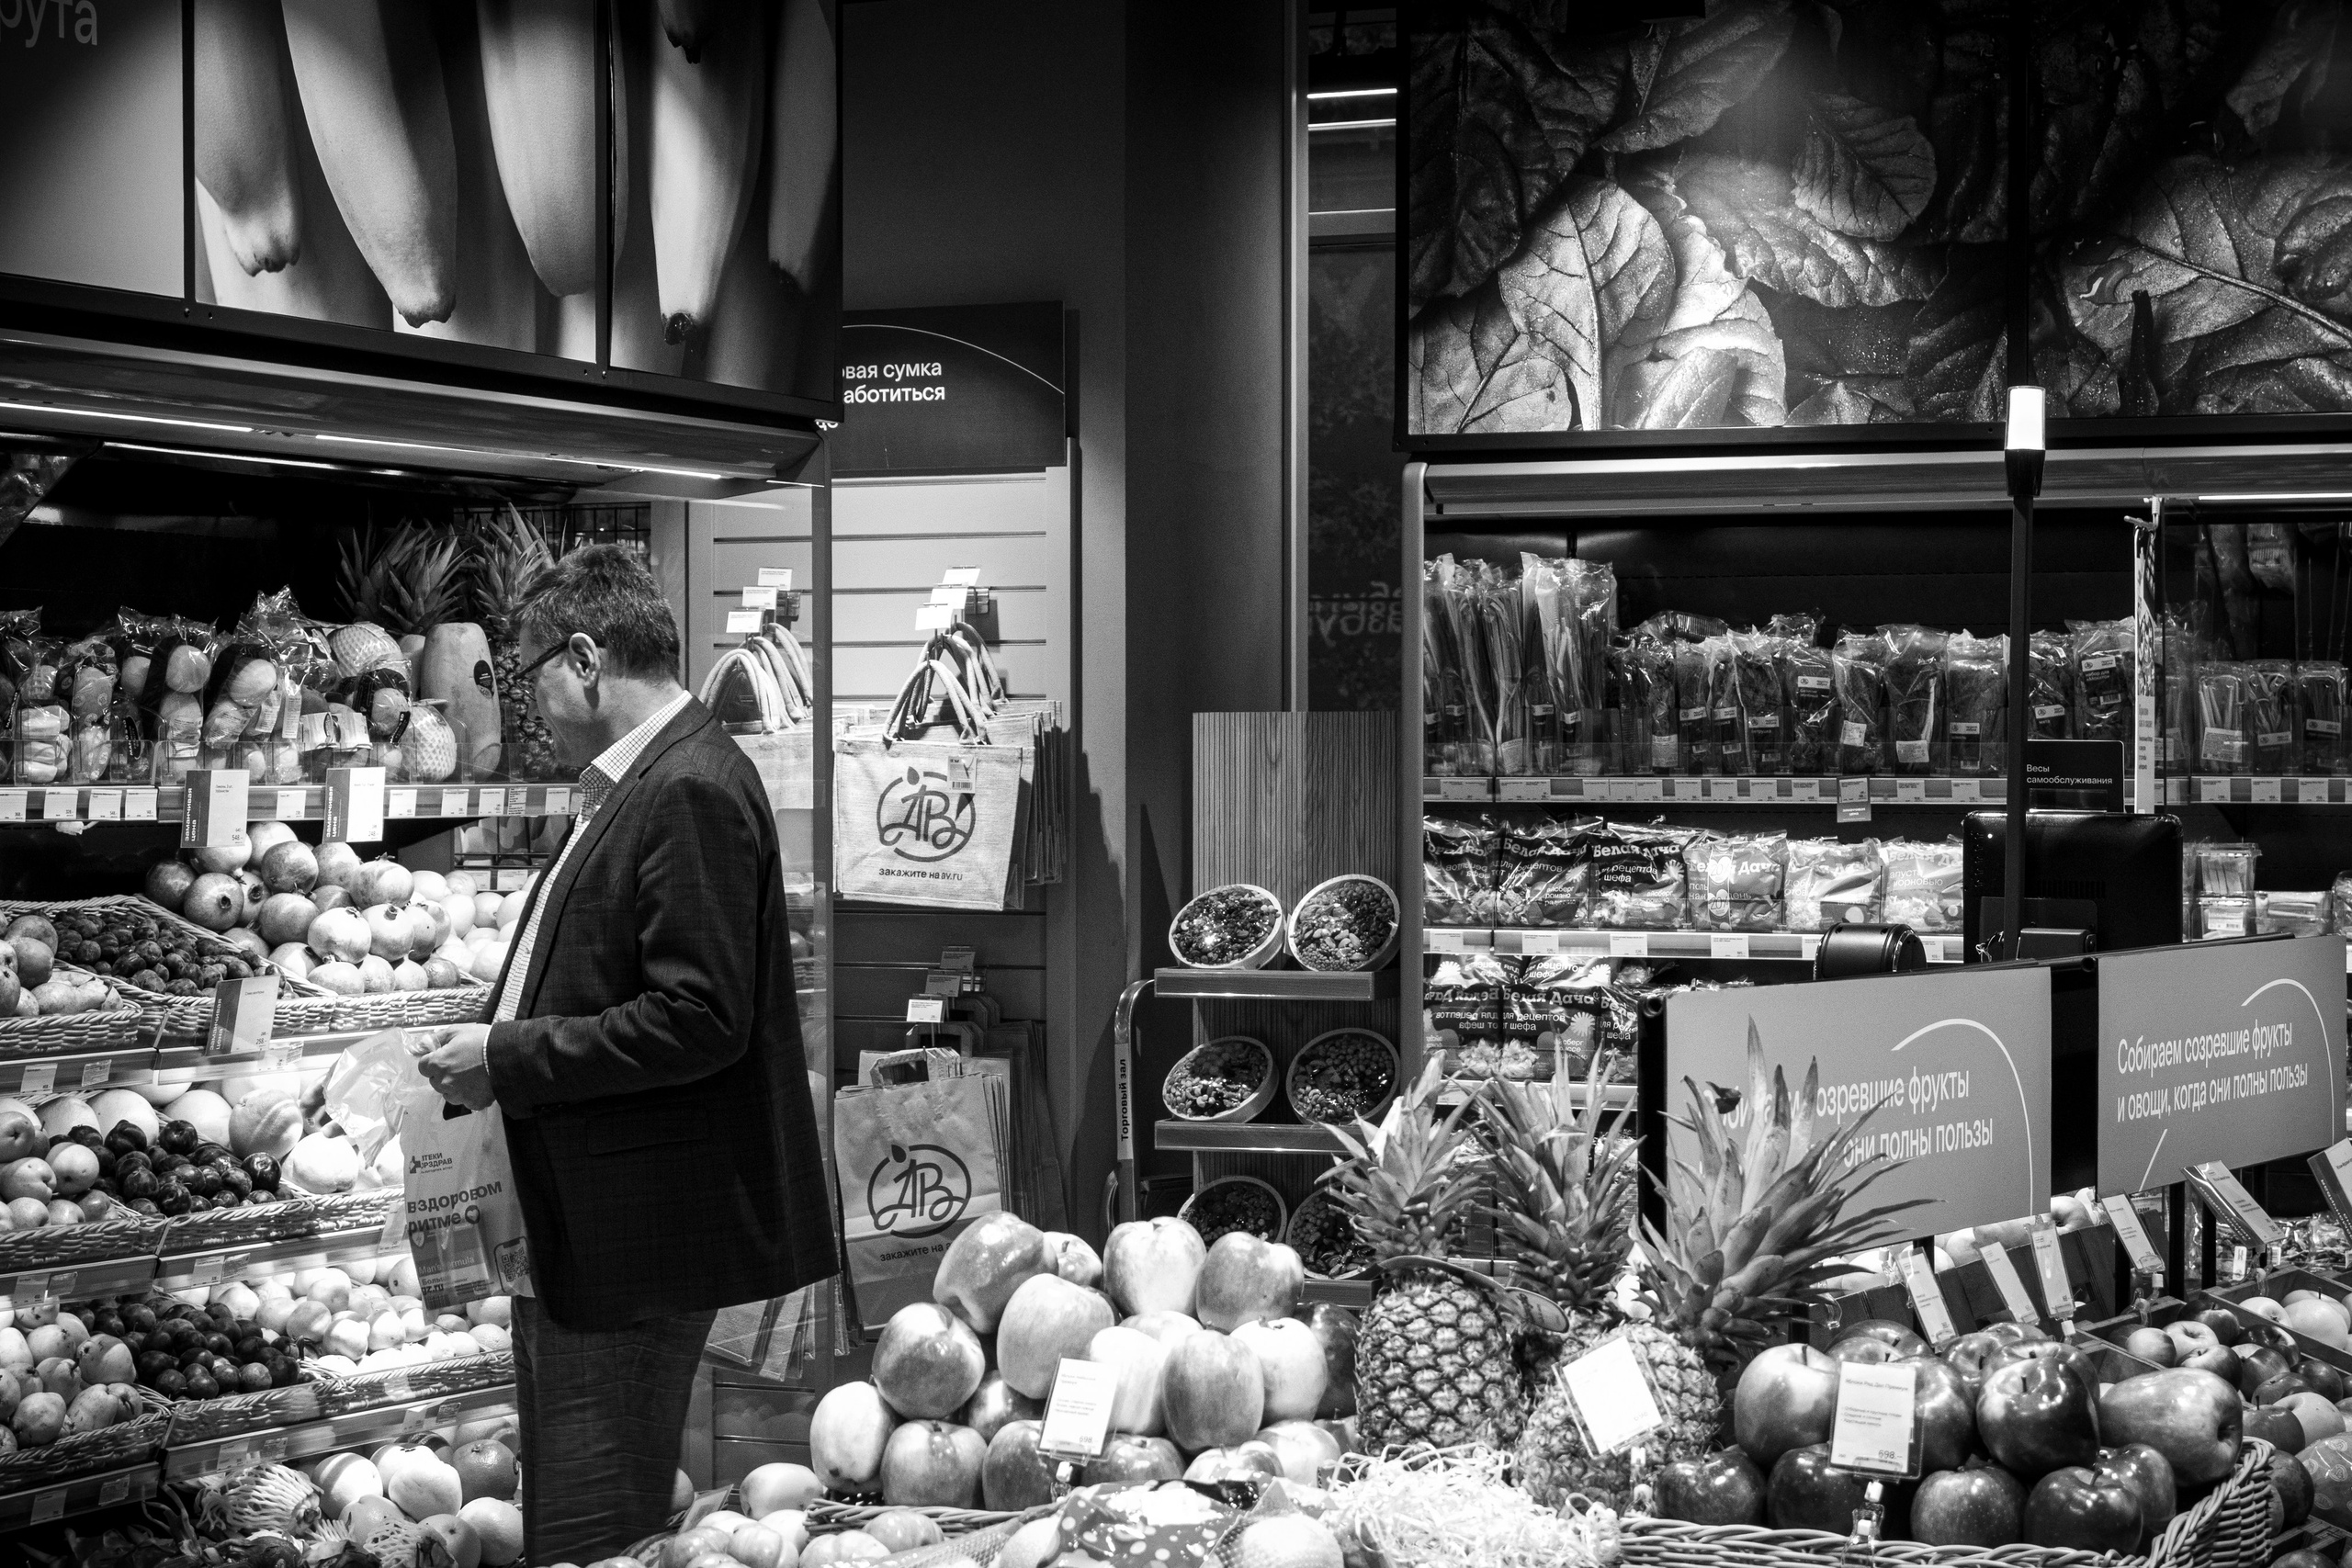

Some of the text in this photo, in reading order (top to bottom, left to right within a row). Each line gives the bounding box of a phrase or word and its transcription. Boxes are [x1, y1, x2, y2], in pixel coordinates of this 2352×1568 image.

[842, 362, 942, 382] вая сумка
[843, 384, 945, 403] аботиться
[2026, 763, 2050, 773] Весы
[2026, 775, 2113, 785] самообслуживания
[185, 787, 193, 841] заманчивая
[1591, 844, 1641, 858] Белая
[878, 867, 963, 881] закажите на av.ru
[1603, 874, 1632, 883] шефа
[1549, 992, 1594, 1005] Дача
[1510, 1021, 1537, 1032] шефа
[1606, 1031, 1631, 1041] шефа
[2118, 1019, 2292, 1077] Собираем созревшие фрукты
[1816, 1077, 1904, 1122] озревшие
[1908, 1066, 1970, 1114] фрукты
[2117, 1063, 2308, 1122] и овощи, когда они полны пользы
[1119, 1082, 1130, 1142] Торговый
[1843, 1132, 1874, 1168] они
[1880, 1126, 1931, 1164] полны
[1936, 1117, 1993, 1151] пользы
[408, 1212, 461, 1235] ритме
[879, 1246, 929, 1262] закажите
[931, 1244, 944, 1253] на
[450, 1256, 475, 1269] rmula
